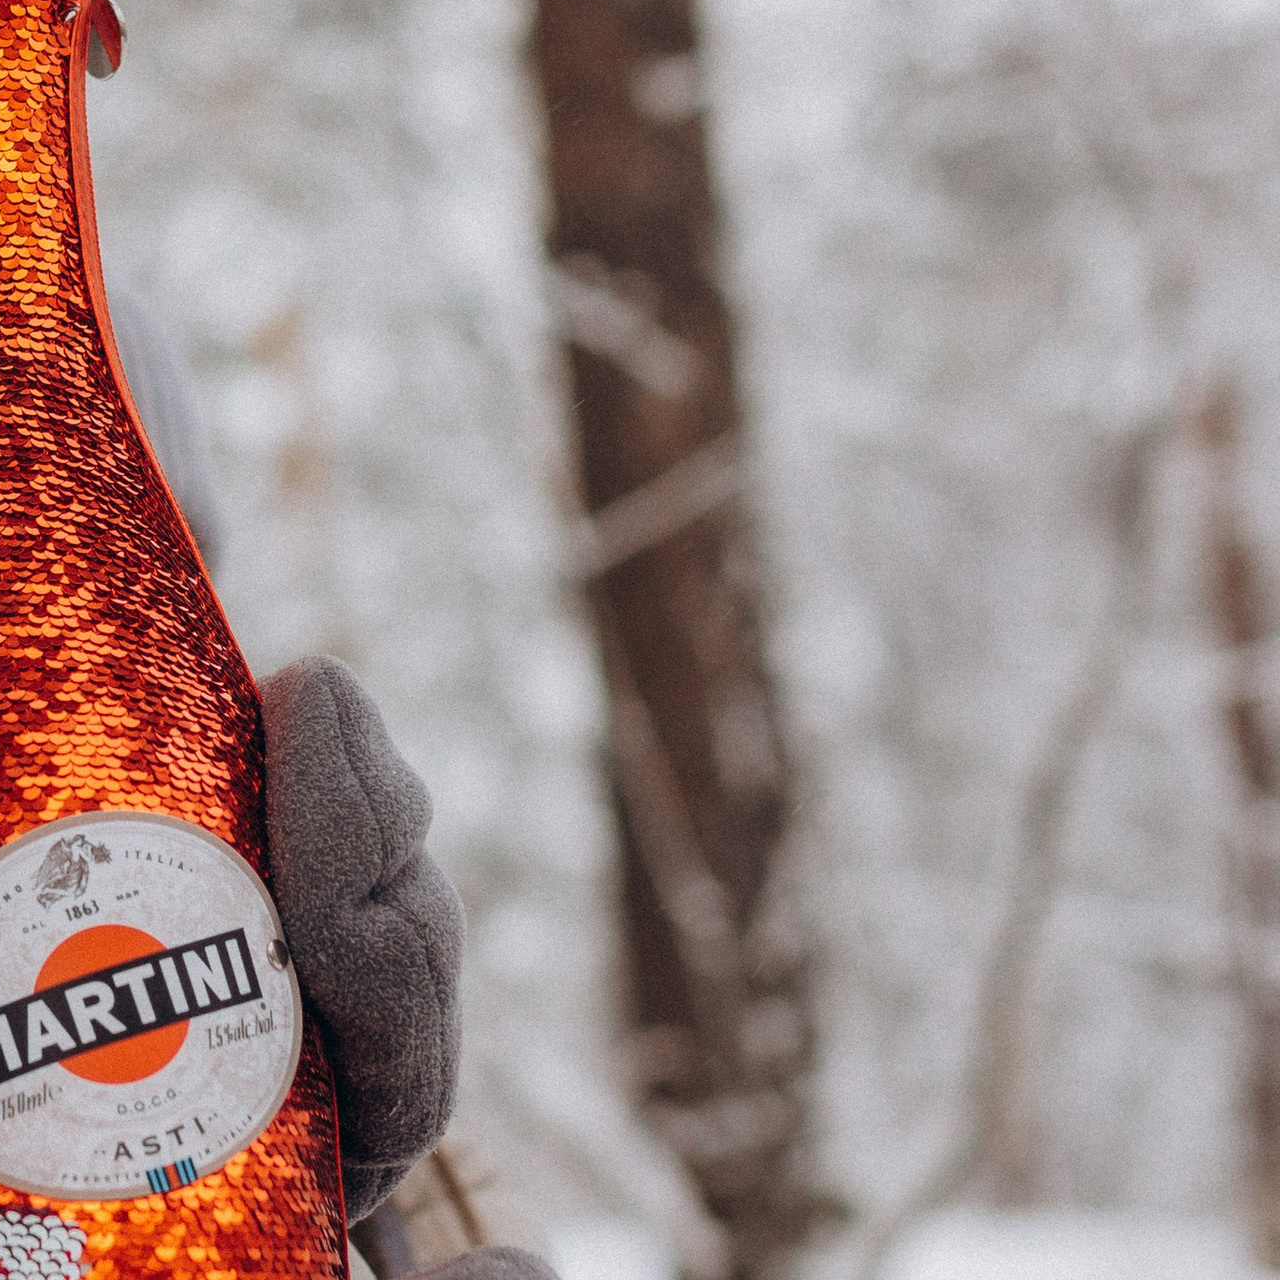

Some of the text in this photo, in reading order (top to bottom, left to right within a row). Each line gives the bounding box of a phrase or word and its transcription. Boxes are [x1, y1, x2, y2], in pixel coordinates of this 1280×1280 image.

[124, 849, 184, 871] ITALIA
[64, 898, 100, 922] 1863
[113, 1115, 206, 1162] ASTI
